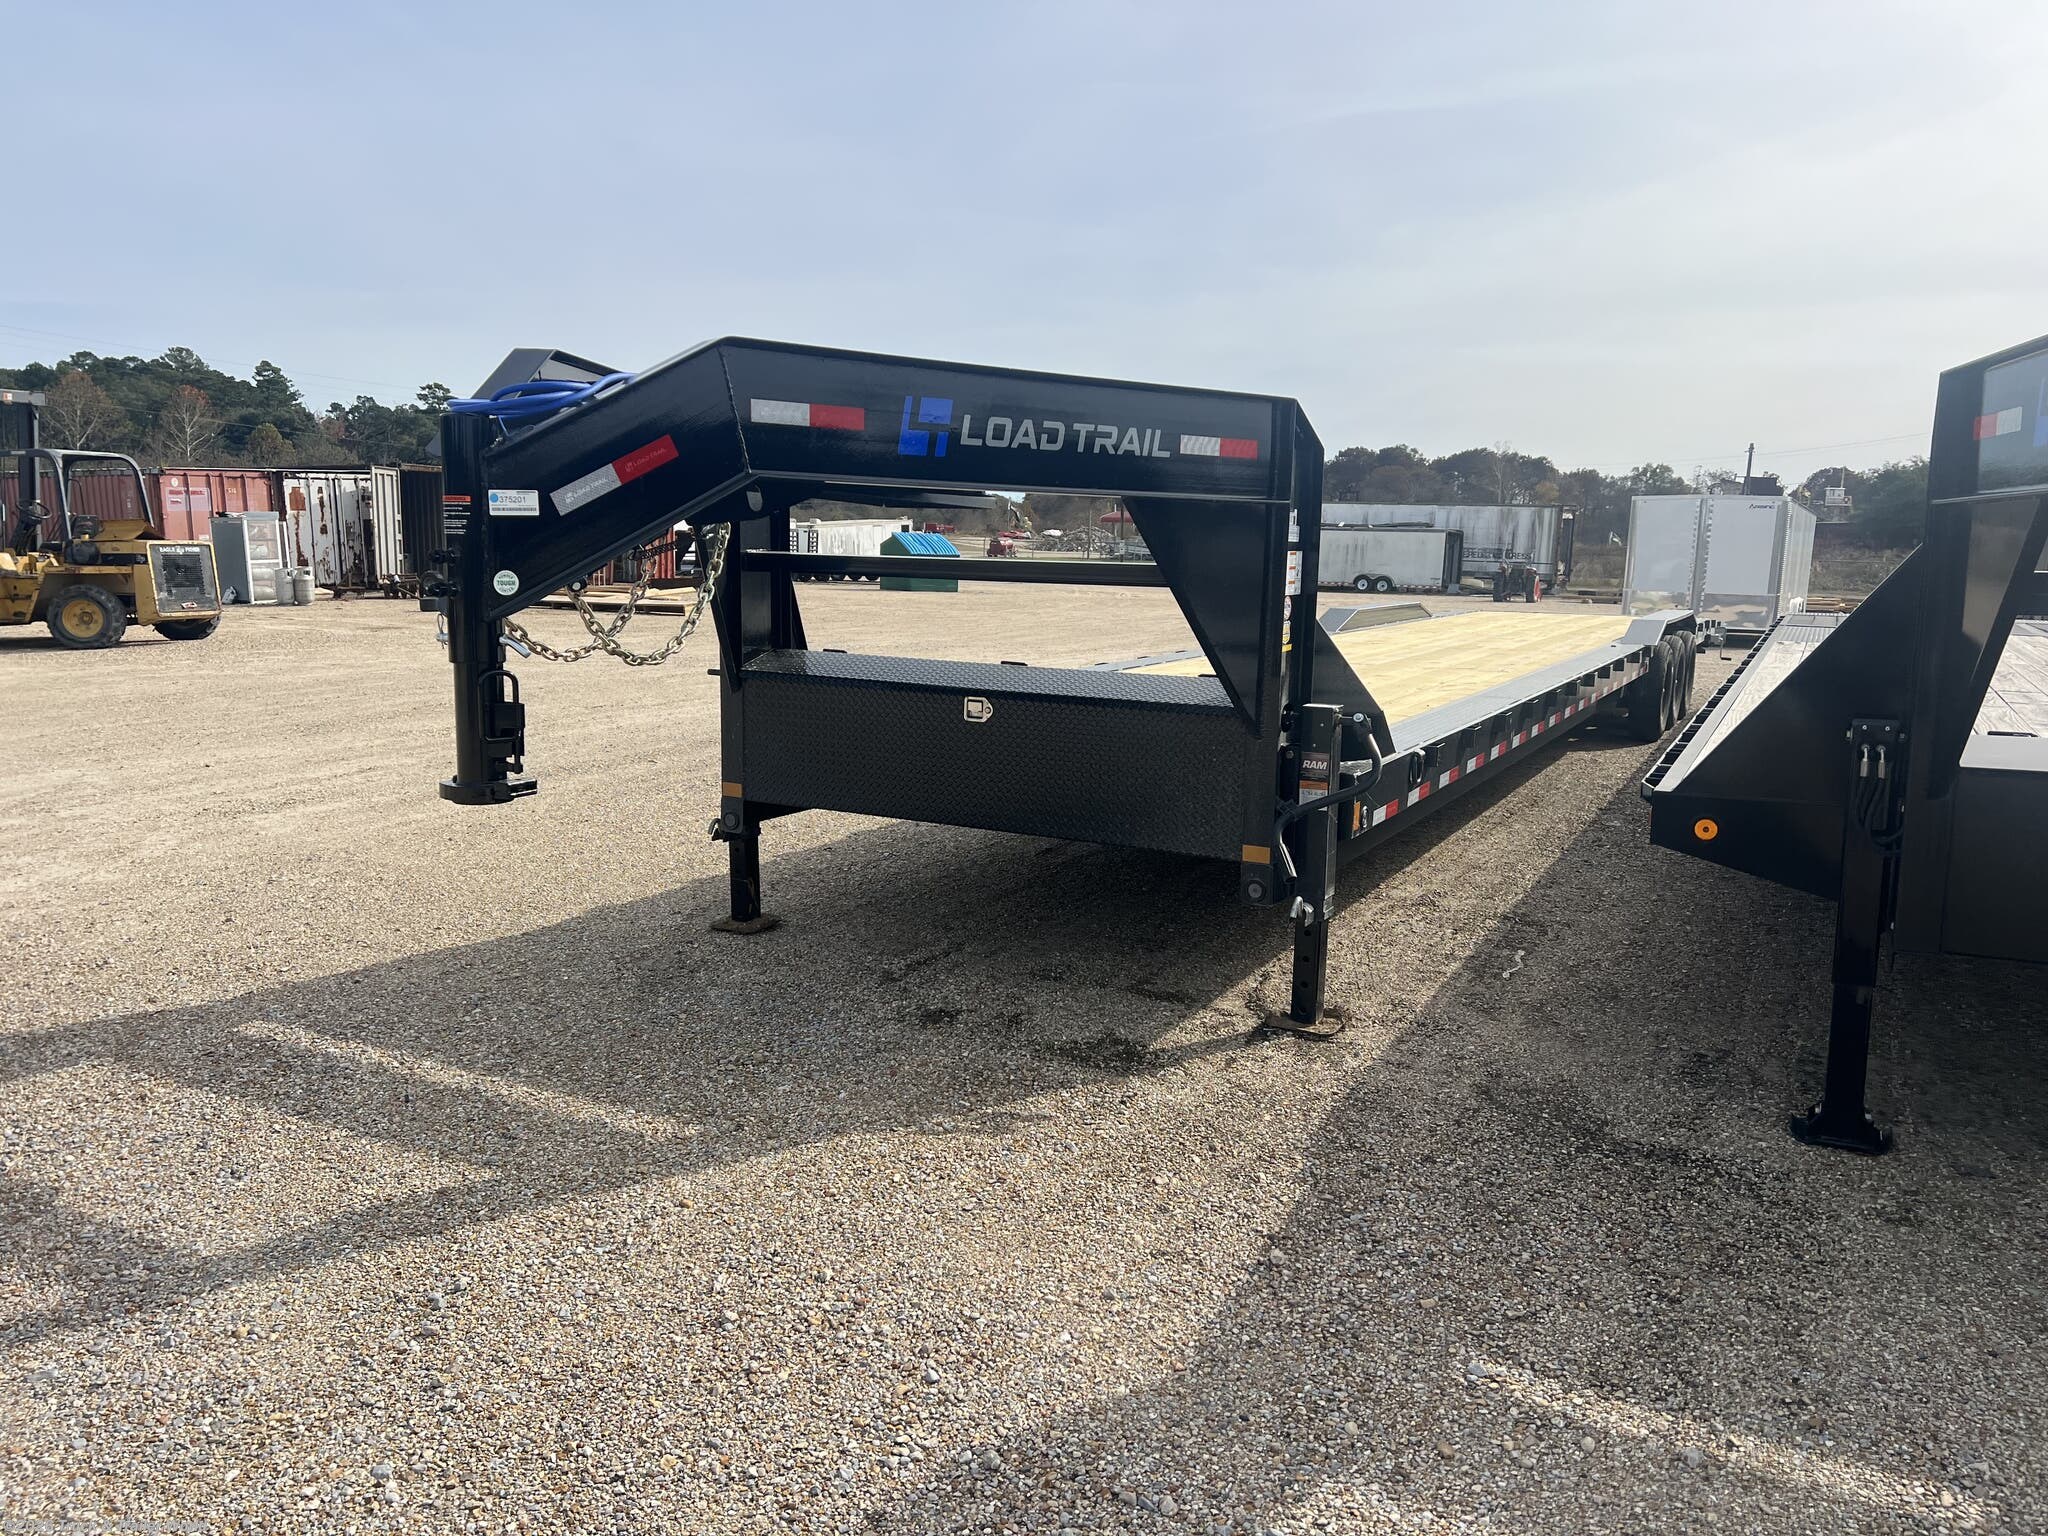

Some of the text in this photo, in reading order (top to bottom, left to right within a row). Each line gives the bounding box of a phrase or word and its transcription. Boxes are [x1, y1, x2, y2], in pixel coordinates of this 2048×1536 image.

[960, 414, 1171, 458] LOAD TRAIL
[499, 495, 526, 503] 375201
[1302, 760, 1328, 770] RAM
